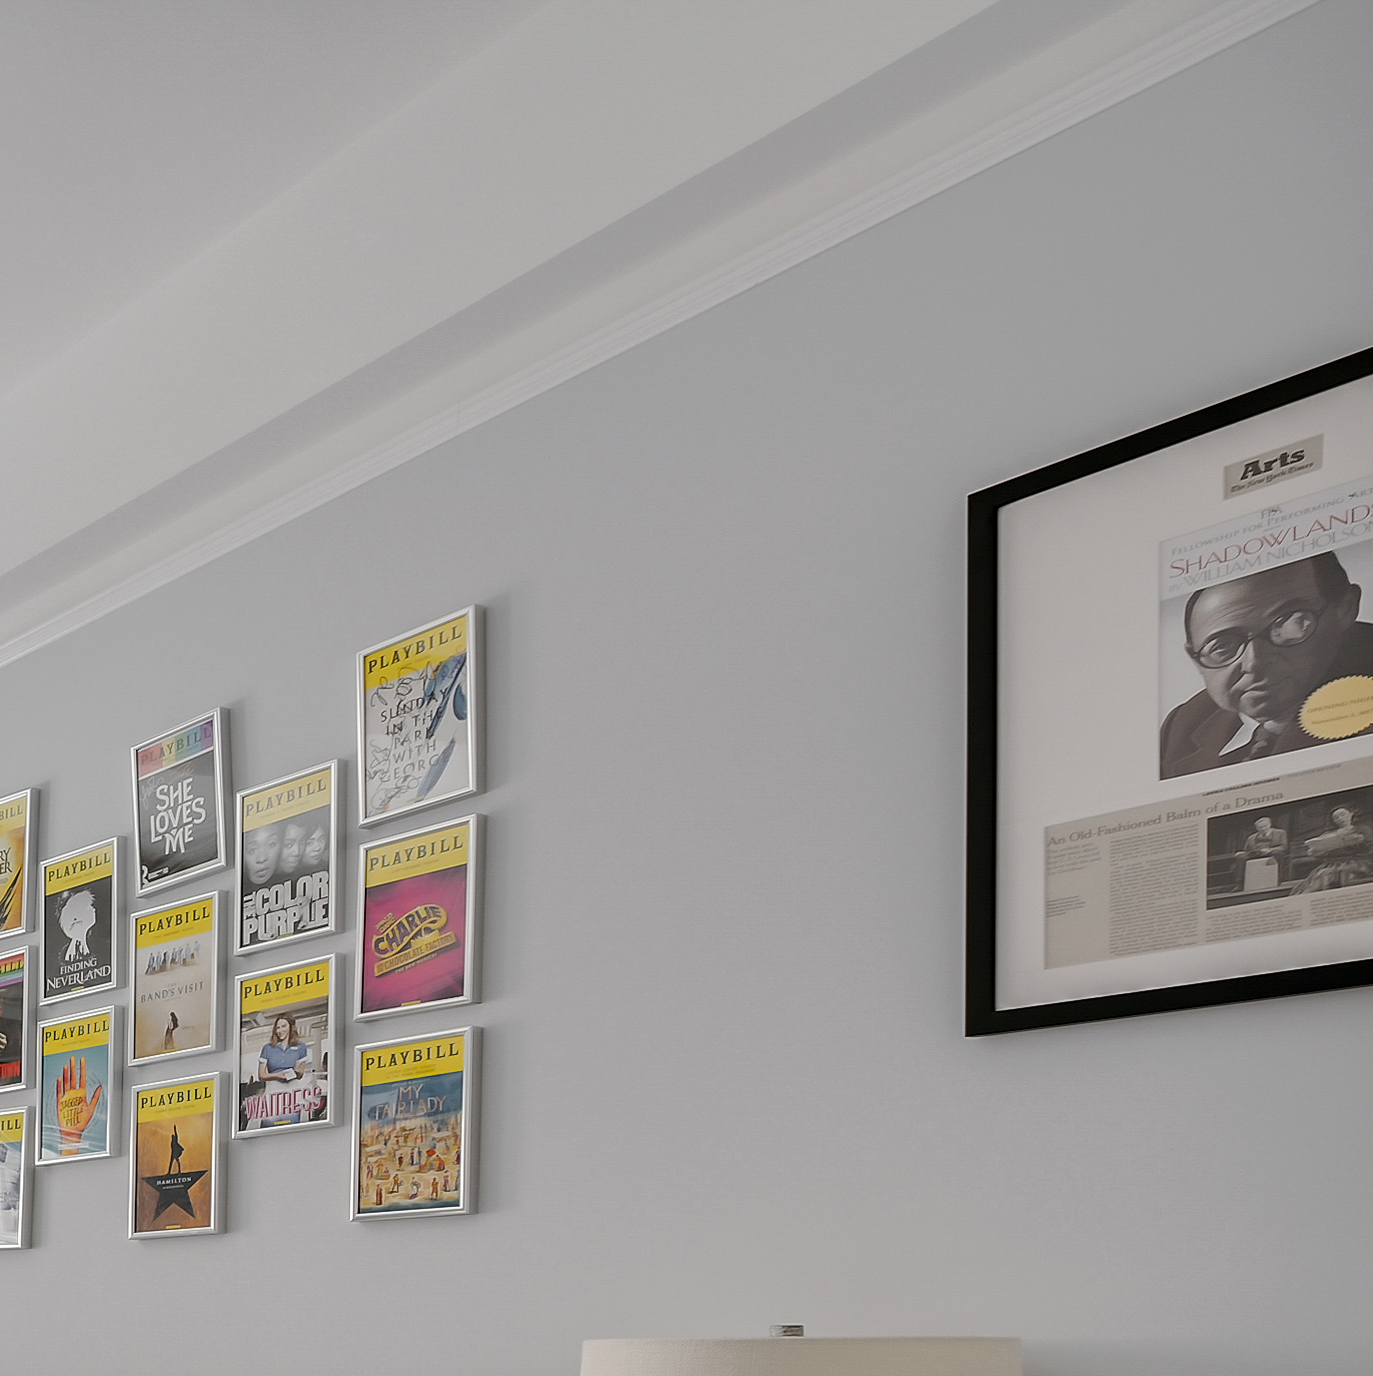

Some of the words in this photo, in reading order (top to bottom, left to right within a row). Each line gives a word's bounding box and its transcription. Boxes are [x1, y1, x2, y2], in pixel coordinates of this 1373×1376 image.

[1230, 481, 1245, 493] The
[1247, 476, 1265, 488] New
[1266, 471, 1286, 483] York
[1288, 462, 1314, 473] Times
[1240, 449, 1305, 480] Arts
[1169, 503, 1373, 578] SHADOWLAND
[1171, 530, 1240, 556] FELLOWSHIP
[1267, 497, 1345, 527] PERFORMING
[1183, 557, 1263, 587] WILLIAM
[367, 625, 463, 675] PLAYBILL
[381, 688, 449, 723] SUNDAY
[140, 726, 211, 766] PLAYBILL
[393, 739, 438, 765] WITH
[394, 727, 435, 751] PARK
[156, 778, 194, 812] SHE
[245, 779, 328, 819] PLAYBILL
[150, 797, 206, 844] LOVES
[1047, 836, 1066, 848] An
[1068, 814, 1162, 842] Old-Fashioned
[1165, 807, 1202, 822] Balm
[1205, 802, 1220, 814] of
[1221, 803, 1231, 811] a
[1234, 791, 1284, 809] Drama
[164, 823, 194, 855] ME
[369, 836, 459, 872] PLAYBILL
[47, 852, 112, 883] PLAYBILL
[255, 870, 330, 918] COLOR
[139, 906, 211, 936] PLAYBILL
[242, 901, 330, 946] PURPLE
[373, 904, 443, 956] CHARLIE
[60, 957, 97, 975] FINDING
[384, 946, 424, 971] CHOCOLATE
[425, 935, 455, 954] FACTORY
[46, 964, 112, 992] NEVERLAND
[178, 981, 205, 996] VISIT
[243, 969, 326, 999] PLAYBILL
[44, 1020, 110, 1043] PLAYBILL
[364, 1043, 460, 1072] PLAYBILL
[59, 1096, 84, 1112] JAGGED
[140, 1087, 212, 1109] PLAYBILL
[245, 1085, 324, 1120] WAITRESS
[404, 1083, 424, 1101] MY
[62, 1106, 85, 1119] LITTLE
[65, 1116, 82, 1128] PILL
[375, 1100, 407, 1121] FAIR
[410, 1095, 447, 1116] LADY
[156, 1176, 192, 1186] HAMILTON
